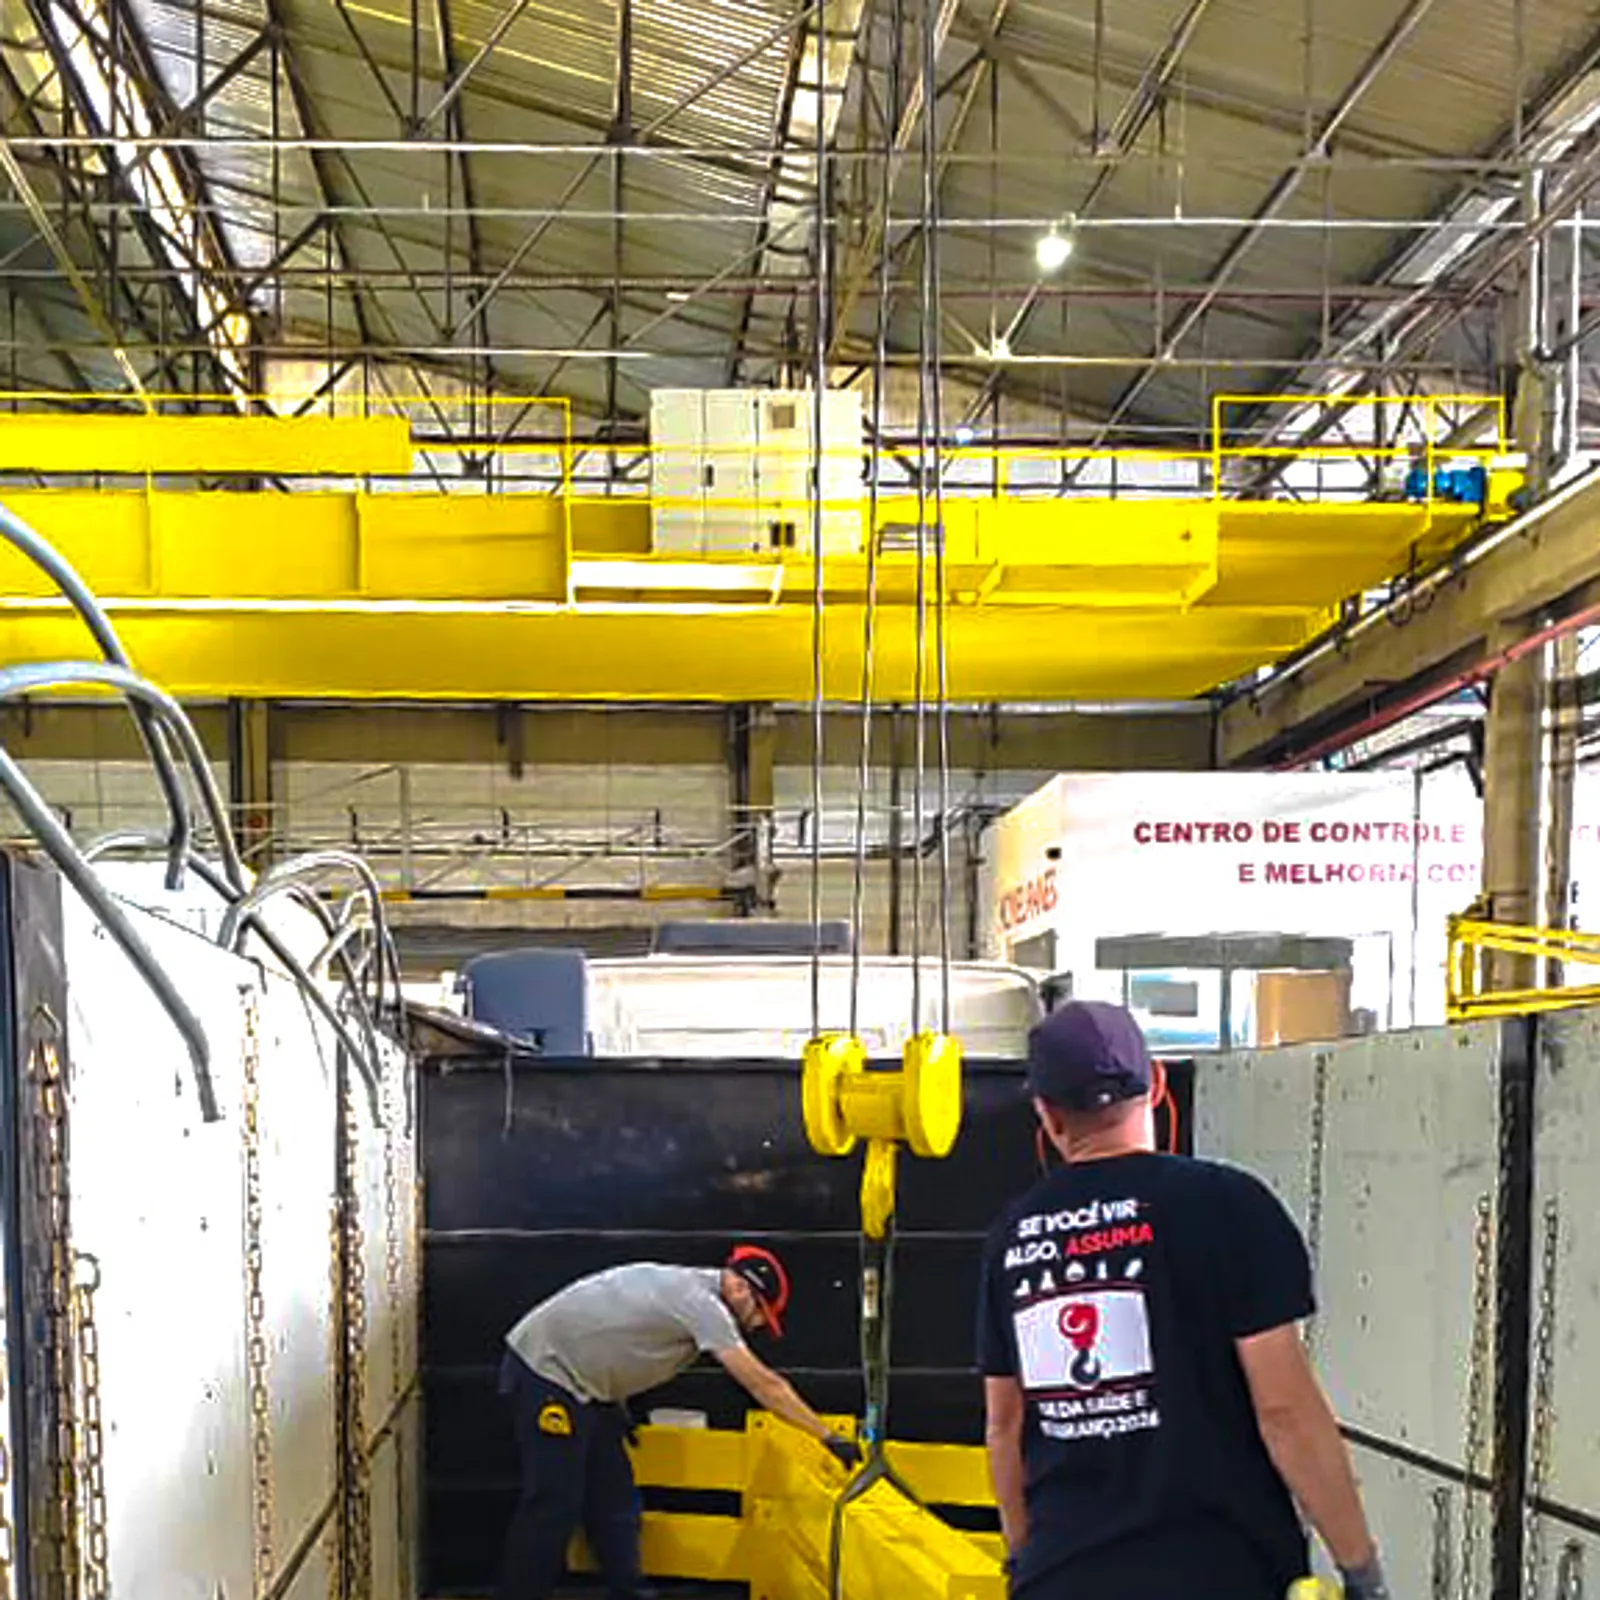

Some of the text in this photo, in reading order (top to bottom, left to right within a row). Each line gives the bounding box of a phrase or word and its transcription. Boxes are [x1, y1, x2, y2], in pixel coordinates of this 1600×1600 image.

[1133, 821, 1466, 844] CENTRO DE CONTROLE
[1237, 863, 1255, 883] E
[1264, 862, 1417, 884] MELHORIA
[1101, 1198, 1138, 1222] VIR
[1064, 1222, 1154, 1256] ASSUMA
